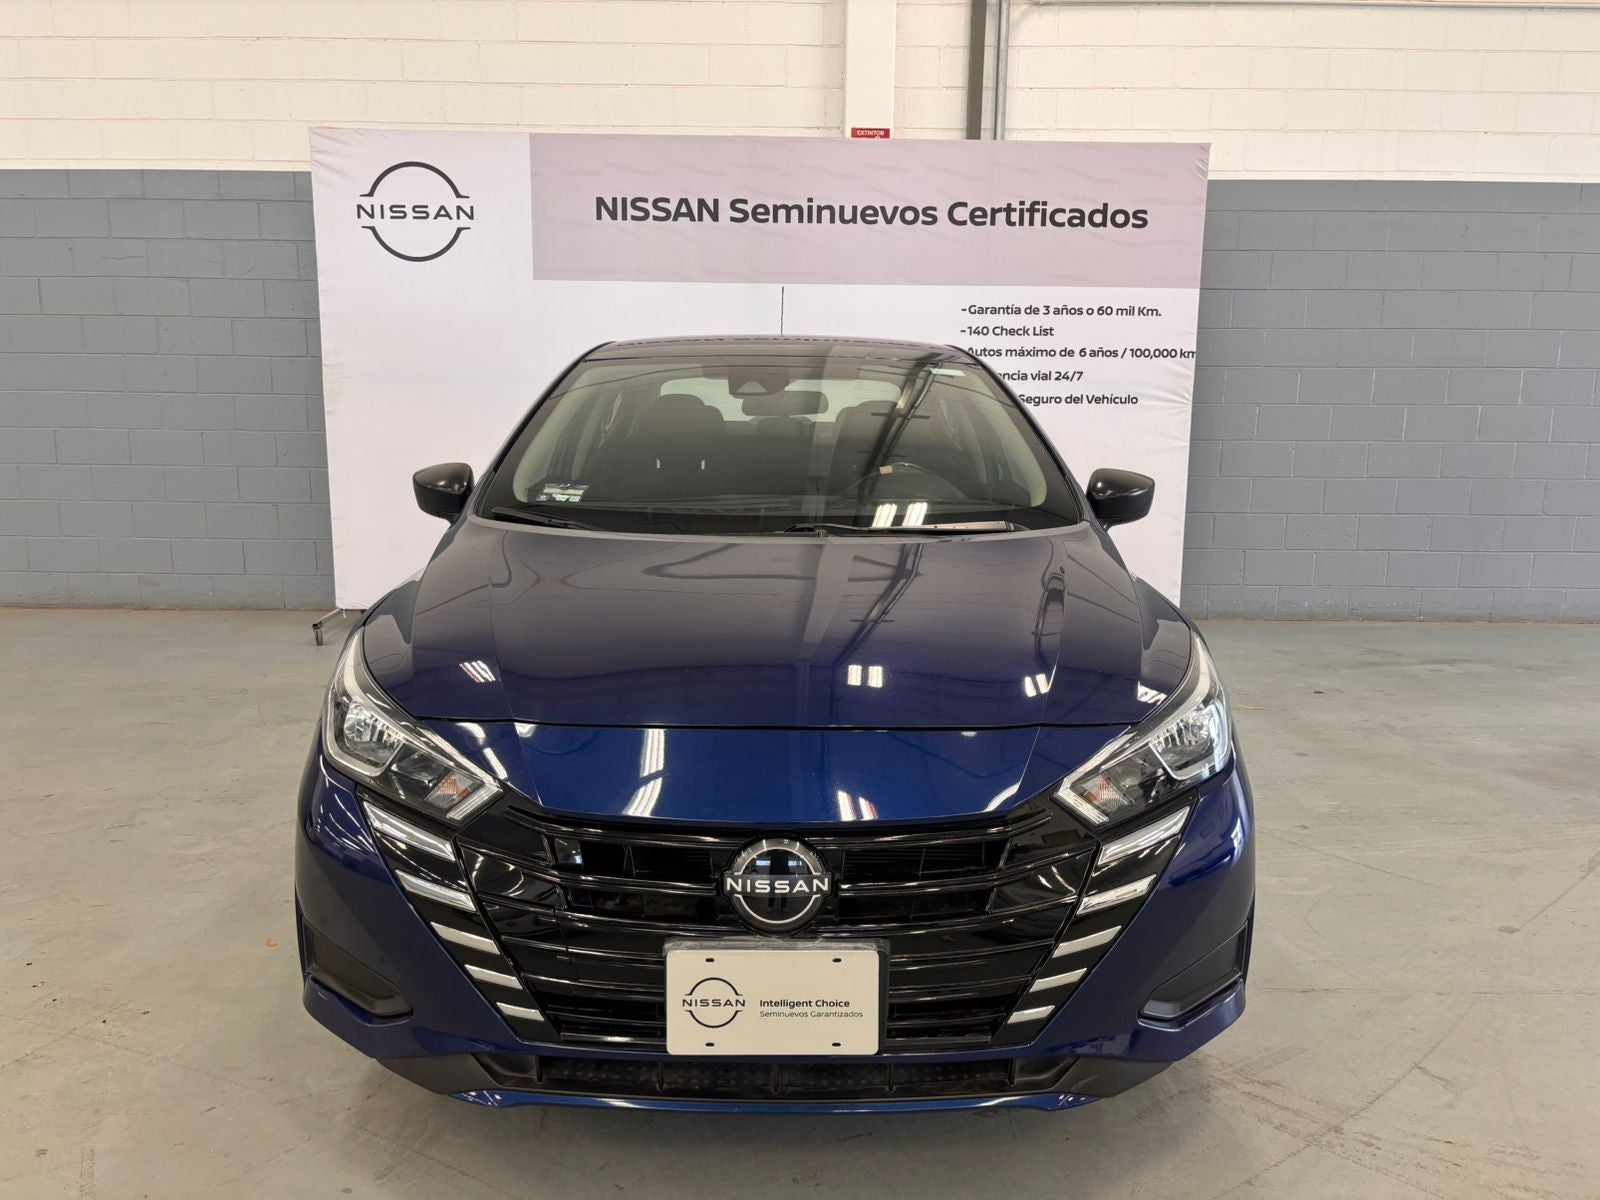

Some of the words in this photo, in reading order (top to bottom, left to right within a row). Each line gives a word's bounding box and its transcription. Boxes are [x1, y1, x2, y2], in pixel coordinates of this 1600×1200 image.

[356, 203, 475, 221] NISSAN
[595, 196, 720, 223] NISSAN
[729, 197, 939, 226] Seminuevos
[947, 200, 1149, 229] Certificados
[1023, 304, 1041, 316] de
[1042, 305, 1051, 316] 3
[1052, 304, 1084, 317] años
[1085, 307, 1095, 317] o
[1096, 305, 1114, 317] 60
[1115, 305, 1136, 317] mil
[1137, 306, 1163, 317] Km.
[991, 325, 1030, 337] Check
[1032, 325, 1055, 337] List
[1005, 346, 1057, 358] máximo
[1058, 346, 1075, 358] de
[1078, 347, 1088, 358] 6
[1088, 346, 1119, 359] años
[1129, 347, 1178, 360] 100,000
[1030, 370, 1052, 381] vial
[1054, 370, 1084, 382] 24/7
[1064, 393, 1084, 405] del
[1085, 393, 1139, 405] Vehículo
[726, 877, 829, 894] NISSAN
[682, 998, 746, 1008] NISSAN
[759, 999, 813, 1010] Intelligent
[815, 999, 851, 1008] Choice
[759, 1010, 809, 1019] Seminuevos
[810, 1010, 864, 1019] Garantizados
